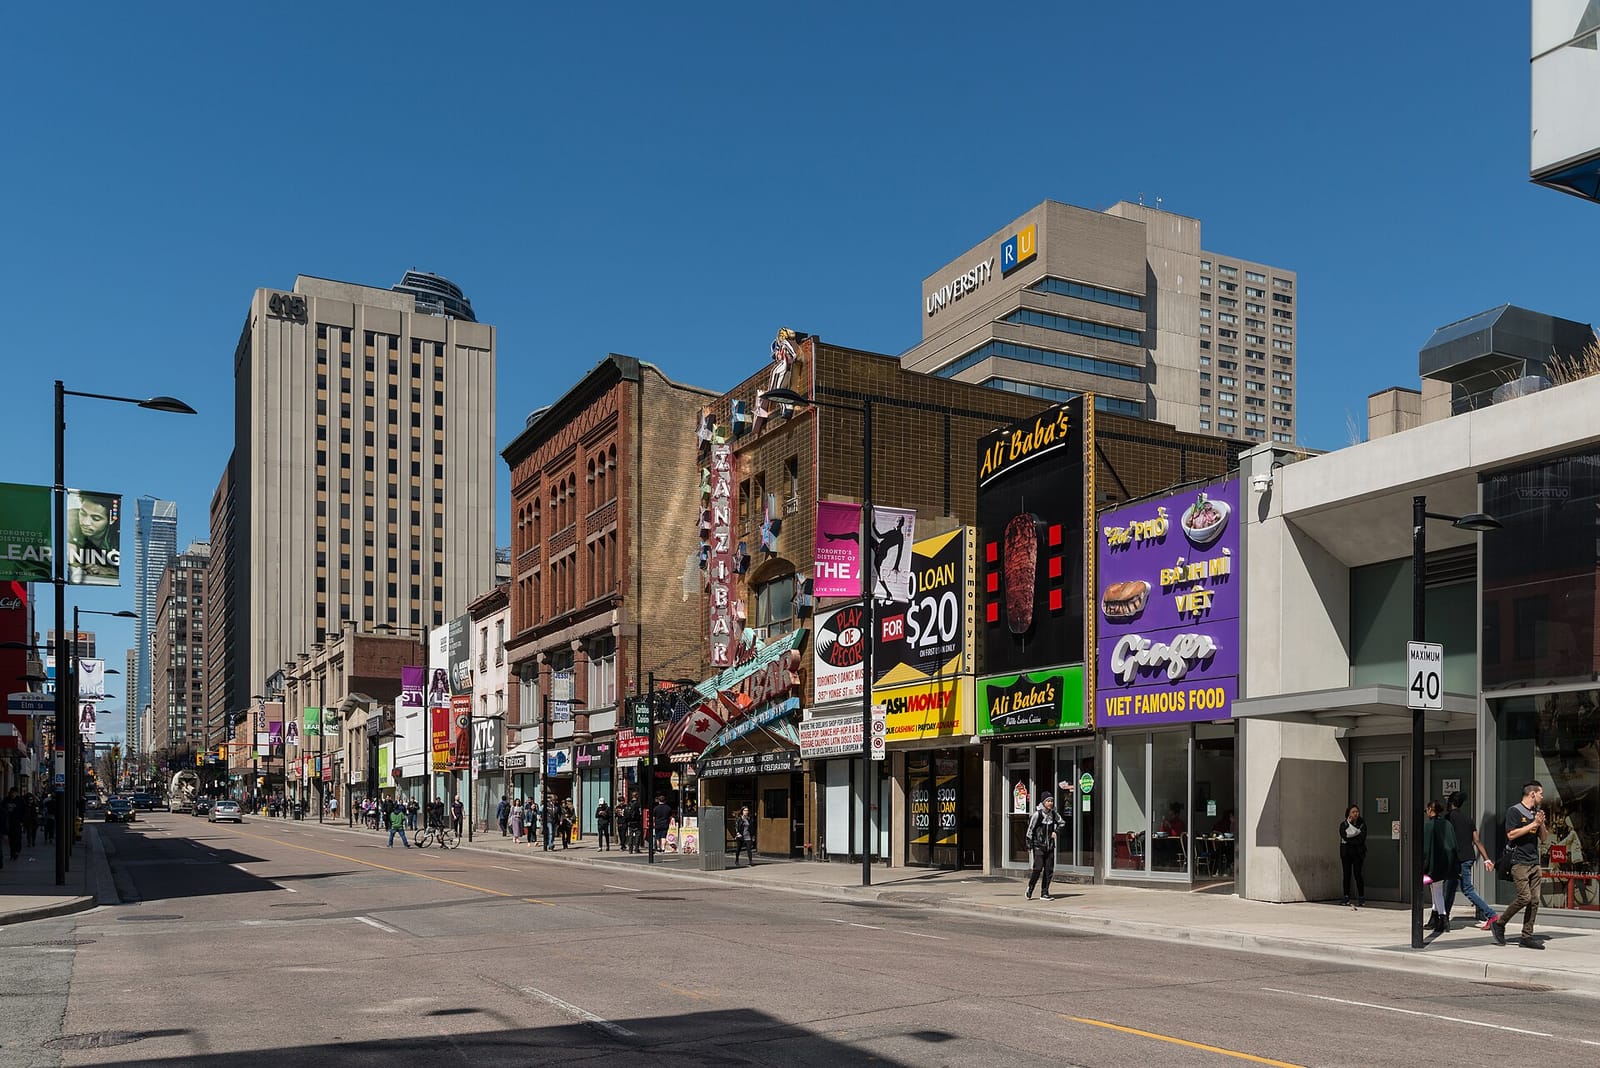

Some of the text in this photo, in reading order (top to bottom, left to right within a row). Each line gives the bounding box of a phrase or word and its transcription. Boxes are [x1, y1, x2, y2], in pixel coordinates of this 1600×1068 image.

[926, 256, 994, 314] UNIVERSITY
[269, 293, 304, 316] 415
[980, 411, 1069, 479] Ali Baba's
[712, 450, 731, 664] ZANZIBAR
[815, 562, 850, 579] THE
[919, 563, 955, 593] LOAN
[836, 606, 863, 630] PLAY
[883, 618, 903, 639] FOR
[906, 591, 958, 649] $20
[844, 632, 855, 646] DE
[1410, 650, 1441, 662] MAXIMUM
[841, 671, 855, 683] DANCE
[1411, 671, 1439, 700] 40
[990, 683, 1055, 716] Ali Baba's
[1106, 687, 1225, 717] VIET FAMOUS FOOD
[474, 719, 494, 750] XTC
[918, 722, 936, 731] PAYDAY
[936, 720, 959, 729] ADVANCE
[937, 788, 956, 801] $300
[1444, 781, 1457, 790] 341
[912, 803, 929, 813] LOAN
[937, 802, 956, 813] LOAN
[916, 814, 929, 827] $20
[942, 814, 956, 827] $20
